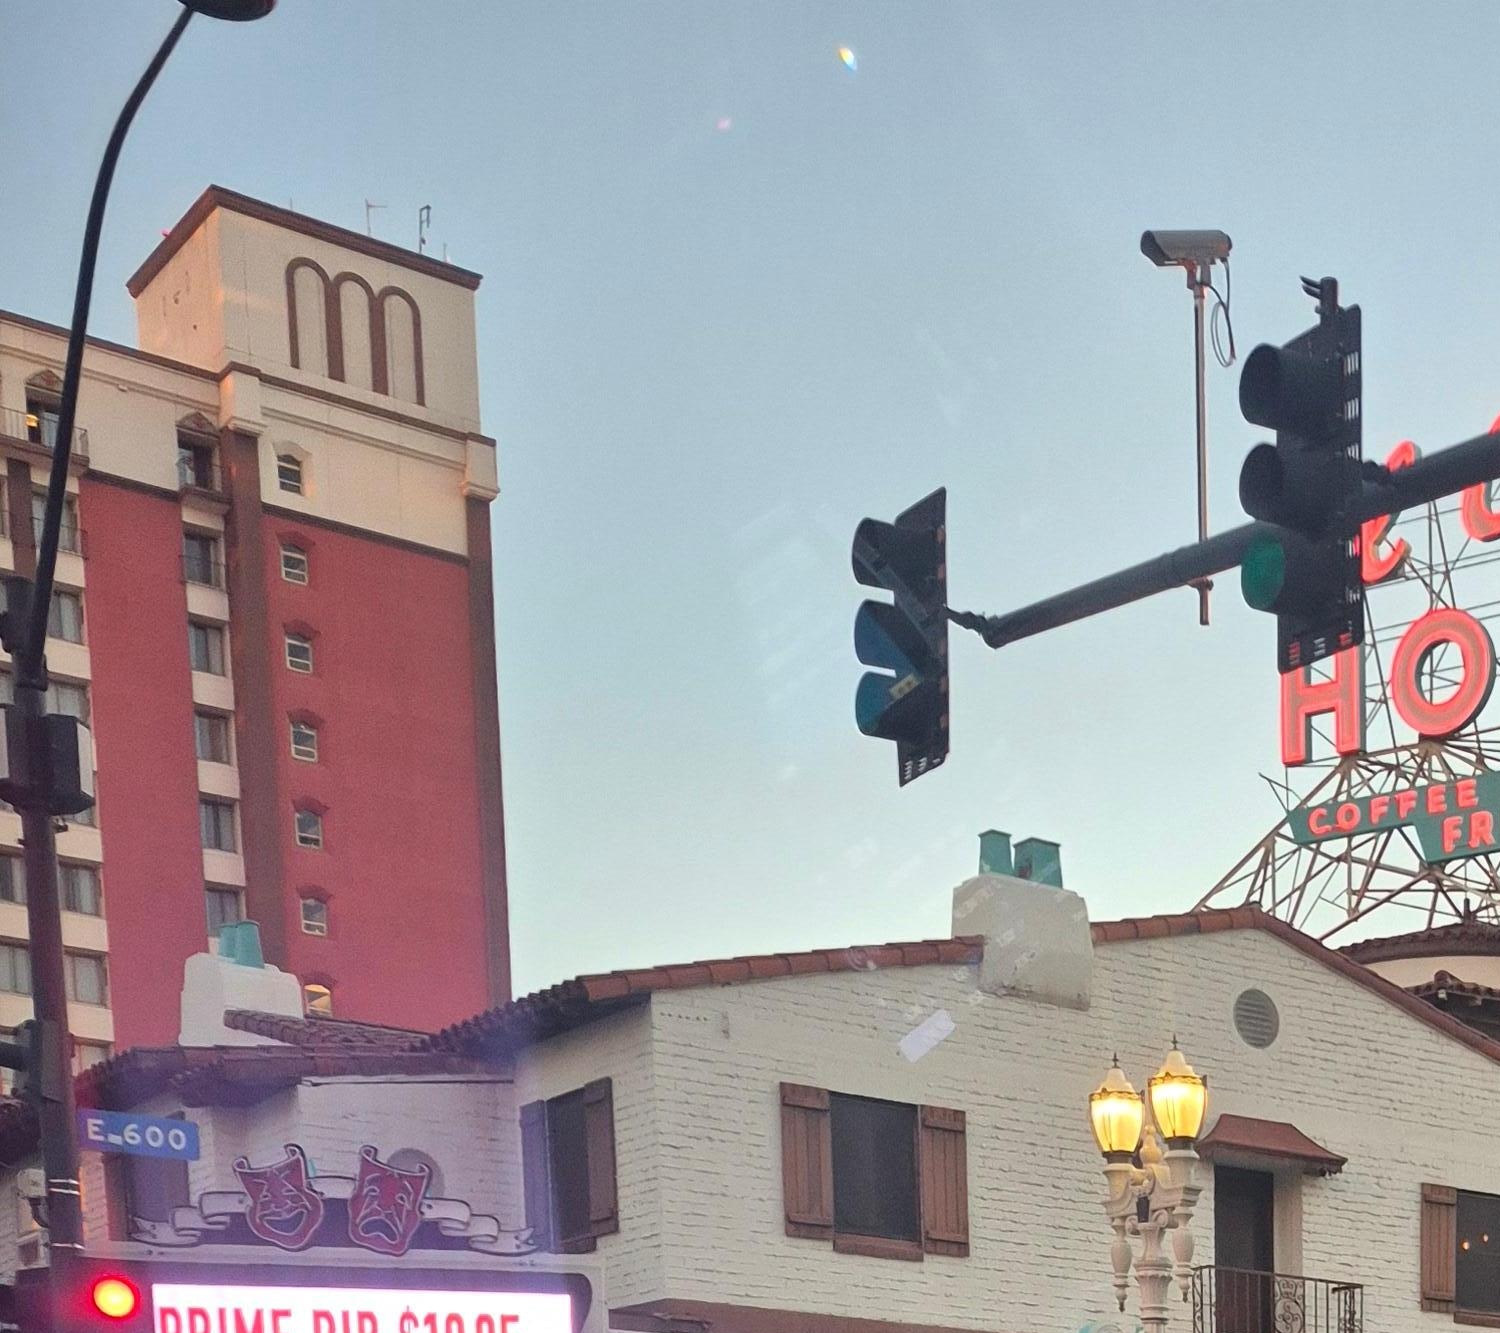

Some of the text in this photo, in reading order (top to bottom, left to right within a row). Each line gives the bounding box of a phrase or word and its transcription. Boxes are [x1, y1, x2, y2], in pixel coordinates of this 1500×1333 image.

[1306, 778, 1480, 836] COFFEE
[87, 1118, 187, 1151] E 600
